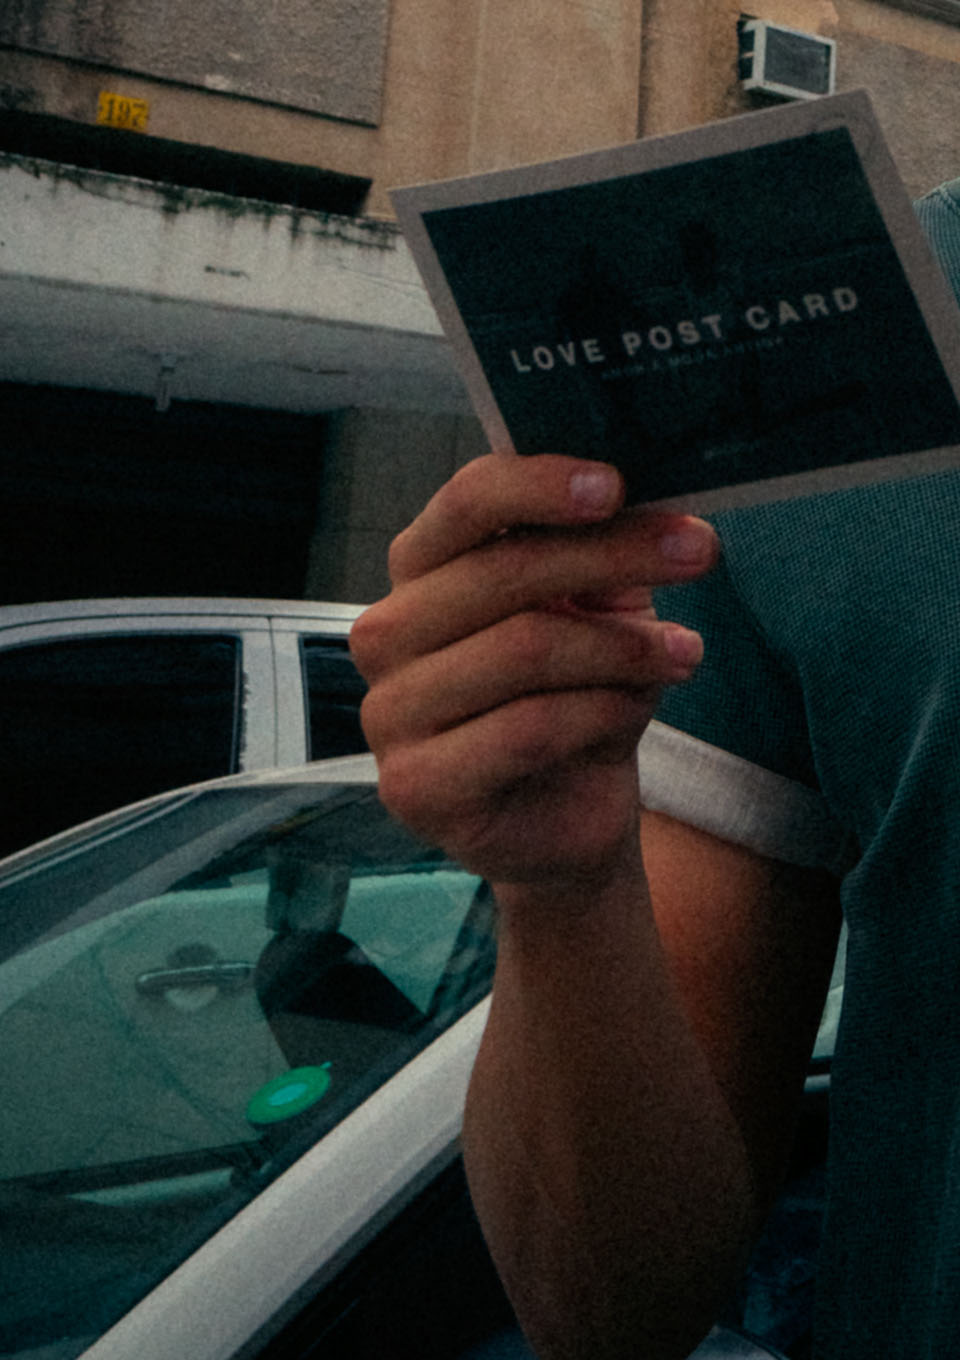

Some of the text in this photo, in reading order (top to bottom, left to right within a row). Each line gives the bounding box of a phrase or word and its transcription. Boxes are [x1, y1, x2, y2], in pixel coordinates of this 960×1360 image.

[104, 97, 146, 128] 197
[511, 339, 605, 373] LOVE
[622, 315, 724, 356] POST
[745, 288, 859, 329] CARD
